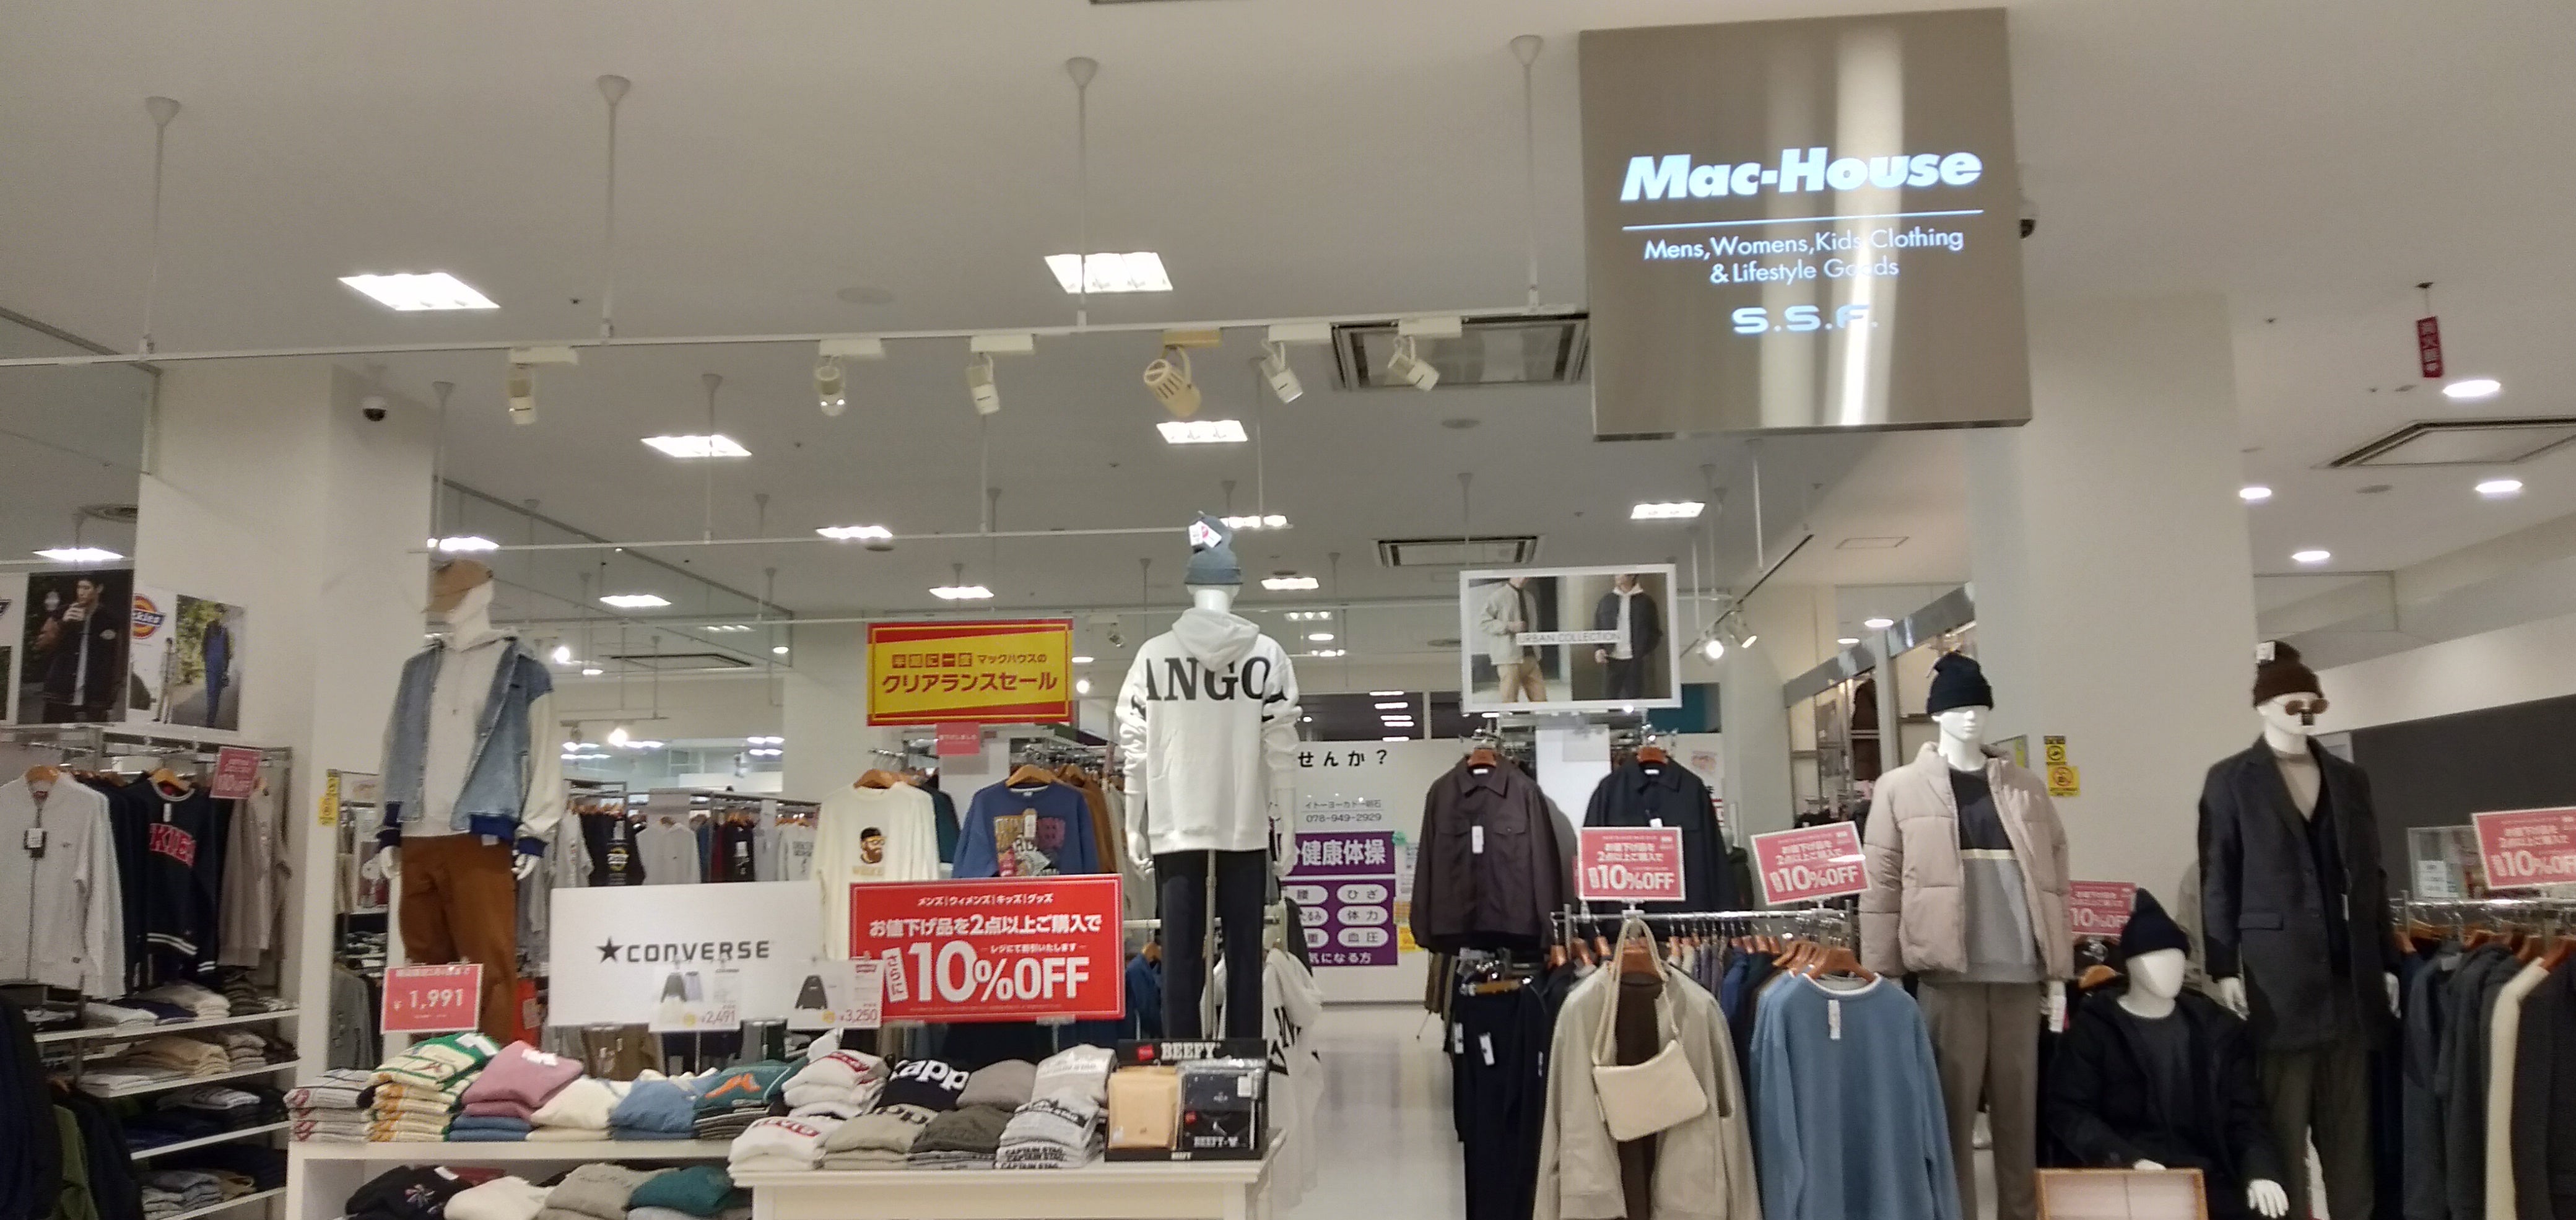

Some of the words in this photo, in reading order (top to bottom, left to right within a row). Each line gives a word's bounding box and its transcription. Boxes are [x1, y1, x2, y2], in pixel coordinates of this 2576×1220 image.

[1621, 147, 1982, 201] Mac-House
[1870, 227, 1964, 251] Clothing
[1710, 264, 1729, 284] &
[1733, 259, 1817, 285] Lifestyle
[1824, 256, 1900, 279] Goods
[883, 671, 1058, 694] クリアランスセール
[1306, 813, 1382, 823] 078-949-2929
[1598, 864, 1674, 890] 10%OFF
[1779, 865, 1858, 891] 10%OFF
[869, 913, 1102, 939] お値下げ品を2点以上ご購入で
[627, 940, 770, 962] CONVERSE
[908, 939, 1090, 1003] 10%OFF
